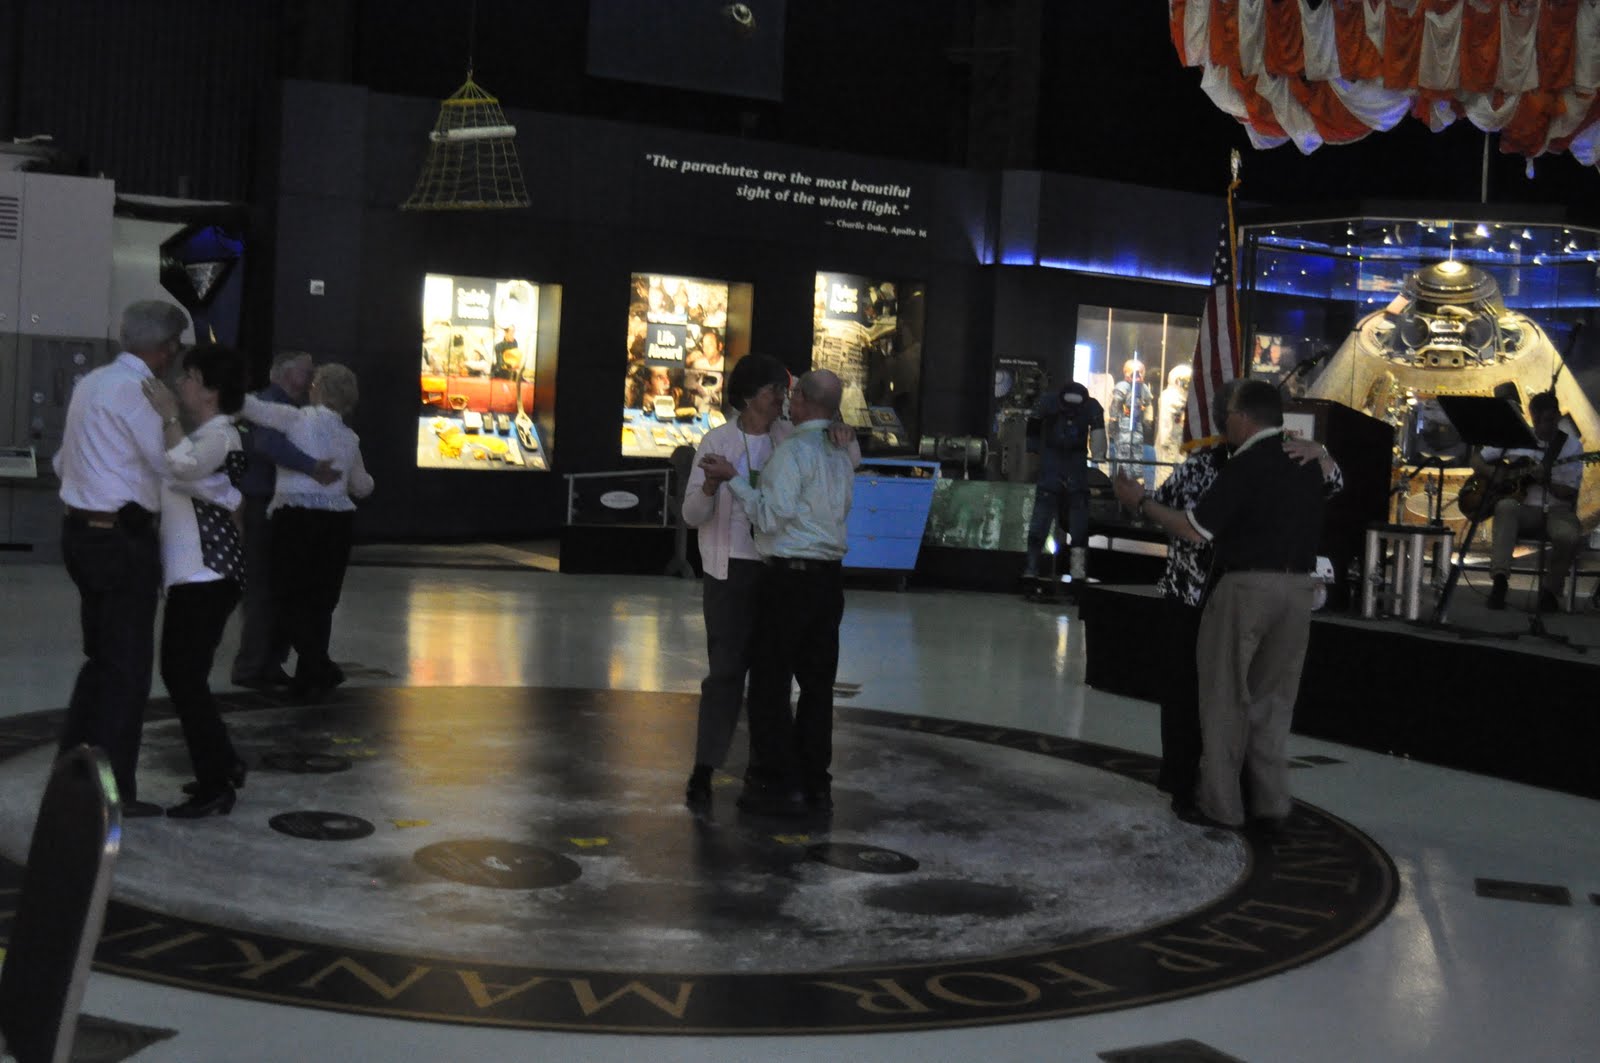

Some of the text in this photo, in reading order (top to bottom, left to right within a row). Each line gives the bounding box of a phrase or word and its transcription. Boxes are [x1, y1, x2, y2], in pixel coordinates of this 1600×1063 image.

[646, 154, 911, 199] "The parachutes are the most beautiful
[736, 184, 910, 217] sight of the whole flight."
[836, 218, 865, 231] Charlie
[867, 222, 888, 235] Duke,
[890, 226, 917, 238] Apollo
[1137, 898, 1337, 973] LEAP
[816, 959, 1118, 1015] FOR
